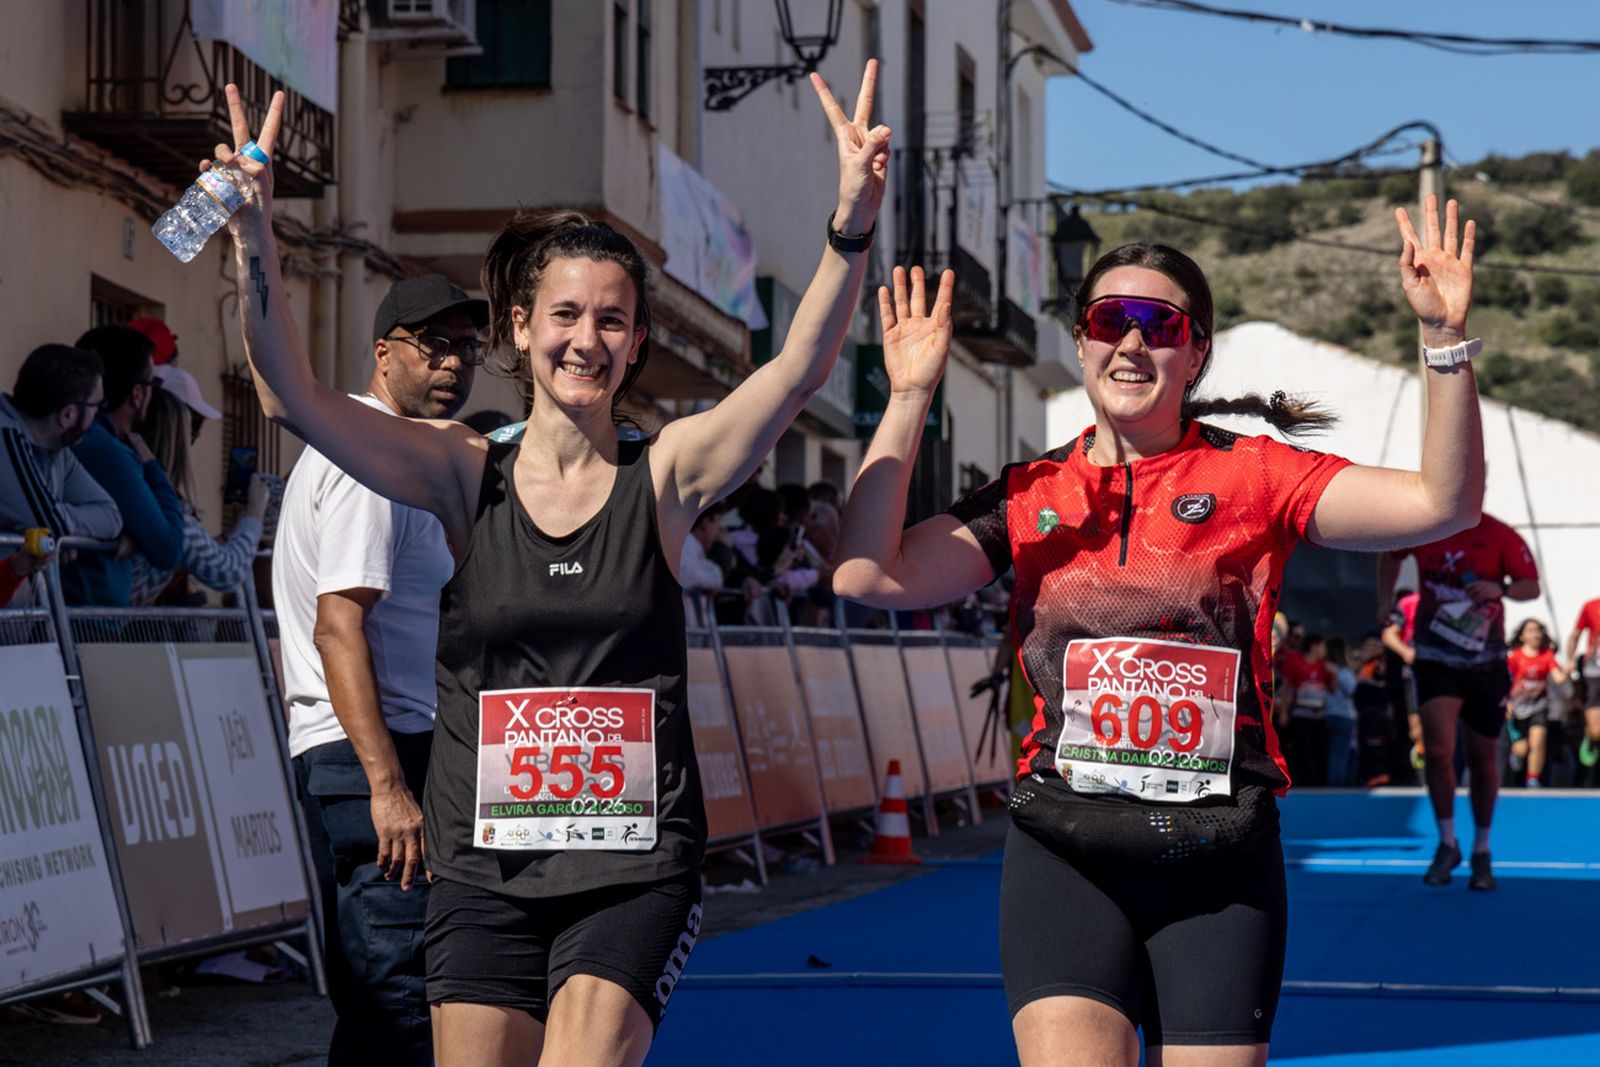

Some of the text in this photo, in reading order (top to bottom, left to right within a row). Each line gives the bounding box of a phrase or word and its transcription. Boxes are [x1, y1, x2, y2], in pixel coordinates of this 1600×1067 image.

[549, 561, 583, 576] FILA
[1089, 648, 1207, 685] X CROSS
[1088, 677, 1186, 700] PANTANO
[505, 699, 624, 729] X CROSS
[1091, 693, 1203, 752] 609
[218, 709, 255, 775] JAÉN
[505, 728, 604, 749] PANTANO
[1062, 747, 1118, 762] CRISTINA
[509, 745, 625, 800] 555
[107, 741, 197, 845] UNED
[491, 803, 534, 816] ELVIRA
[589, 803, 643, 815] ALSO
[231, 811, 283, 858] MARTOS
[44, 843, 96, 878] NETWORK
